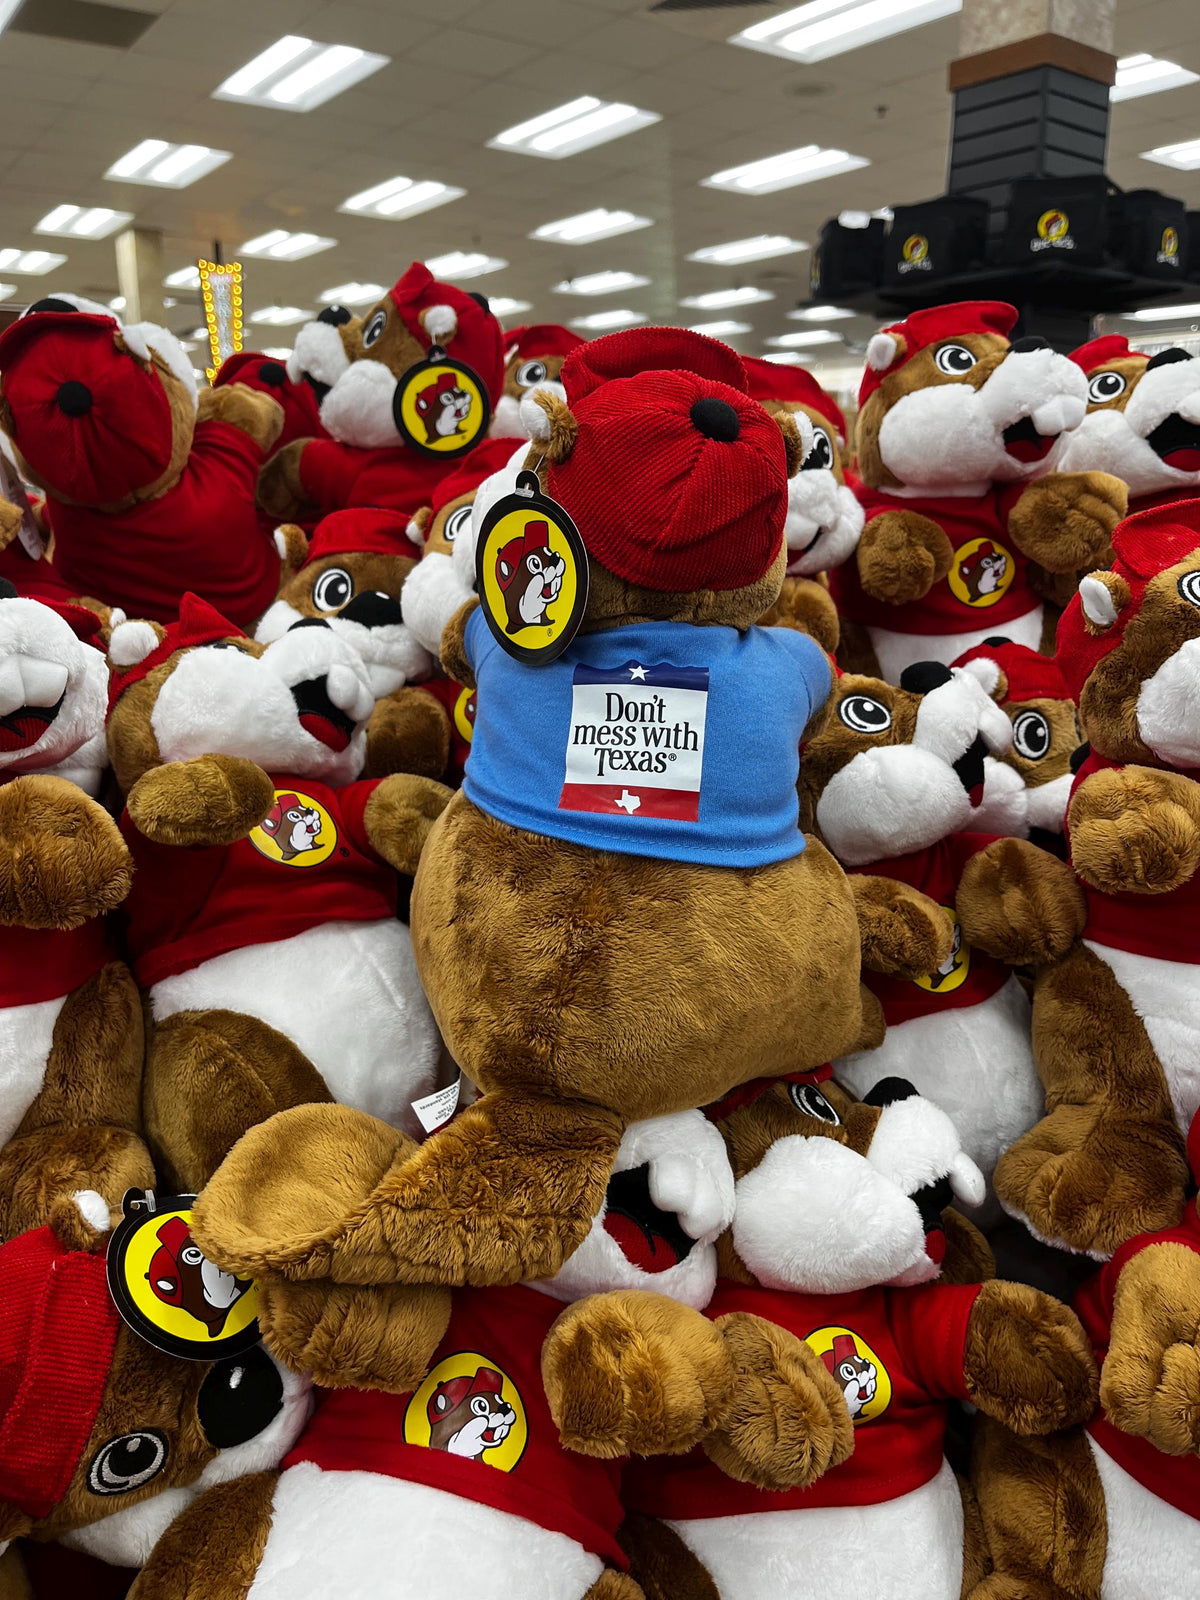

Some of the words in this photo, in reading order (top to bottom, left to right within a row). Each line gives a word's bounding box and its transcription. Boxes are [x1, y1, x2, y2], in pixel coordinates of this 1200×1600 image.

[605, 692, 667, 724] Don't
[572, 724, 637, 746] mess
[642, 721, 699, 752] with
